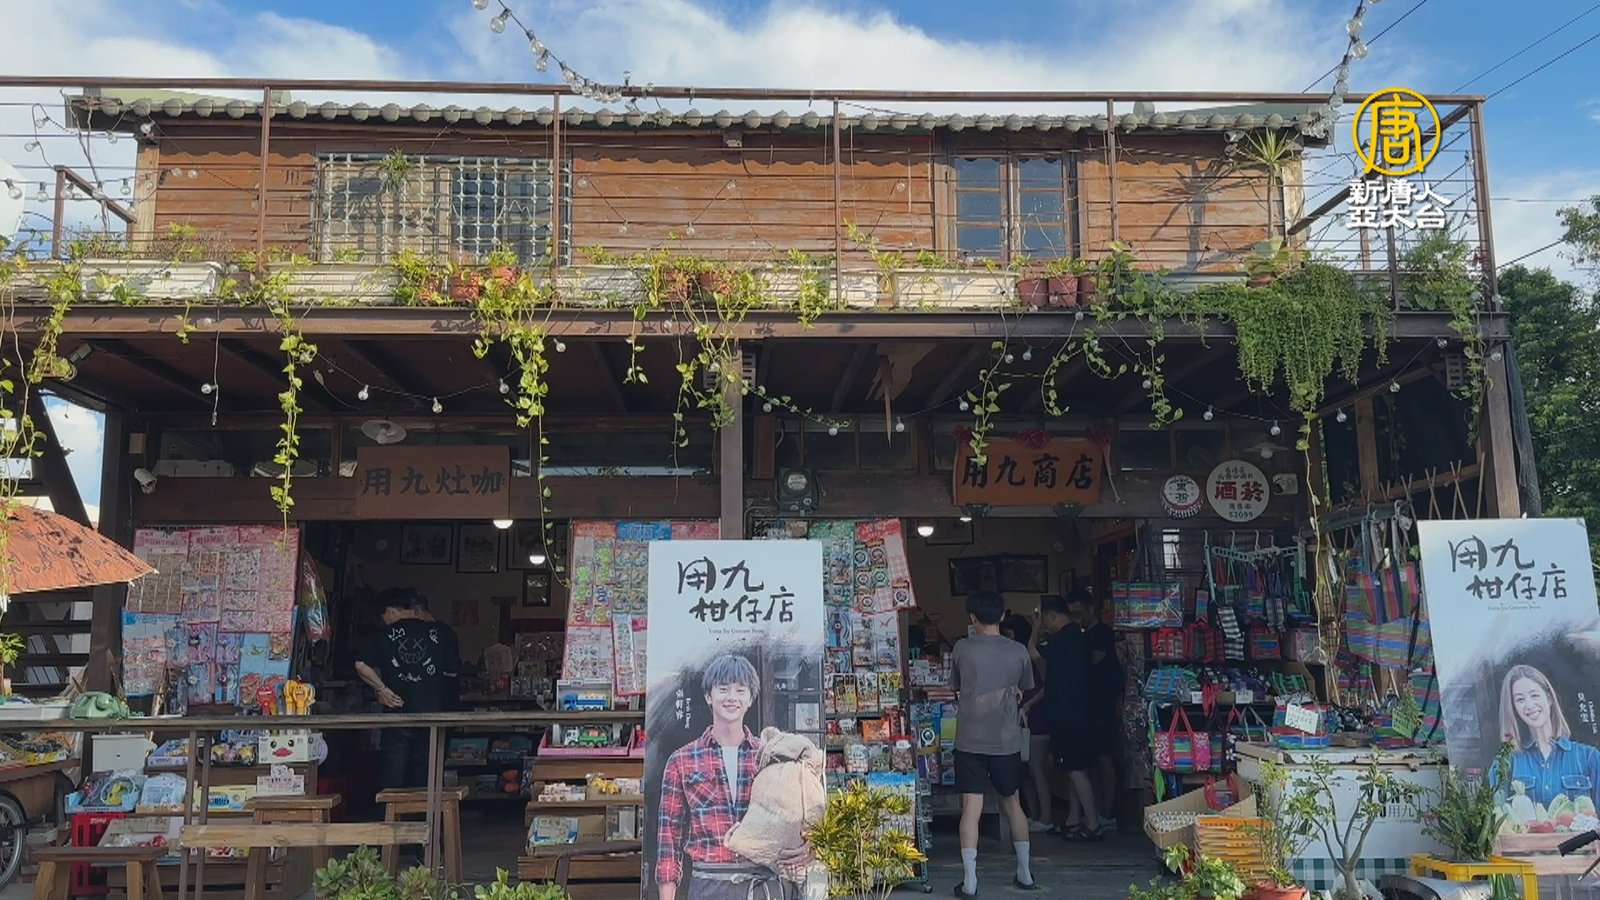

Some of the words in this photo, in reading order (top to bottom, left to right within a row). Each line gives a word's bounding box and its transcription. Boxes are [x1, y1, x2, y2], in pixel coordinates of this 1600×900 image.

[361, 465, 502, 497] 用九灶咖
[962, 453, 1095, 490] 用九商店
[1448, 534, 1535, 573] 用九
[677, 556, 764, 594] 用九
[1465, 562, 1568, 600] 柑仔店
[689, 586, 795, 623] 柑仔店
